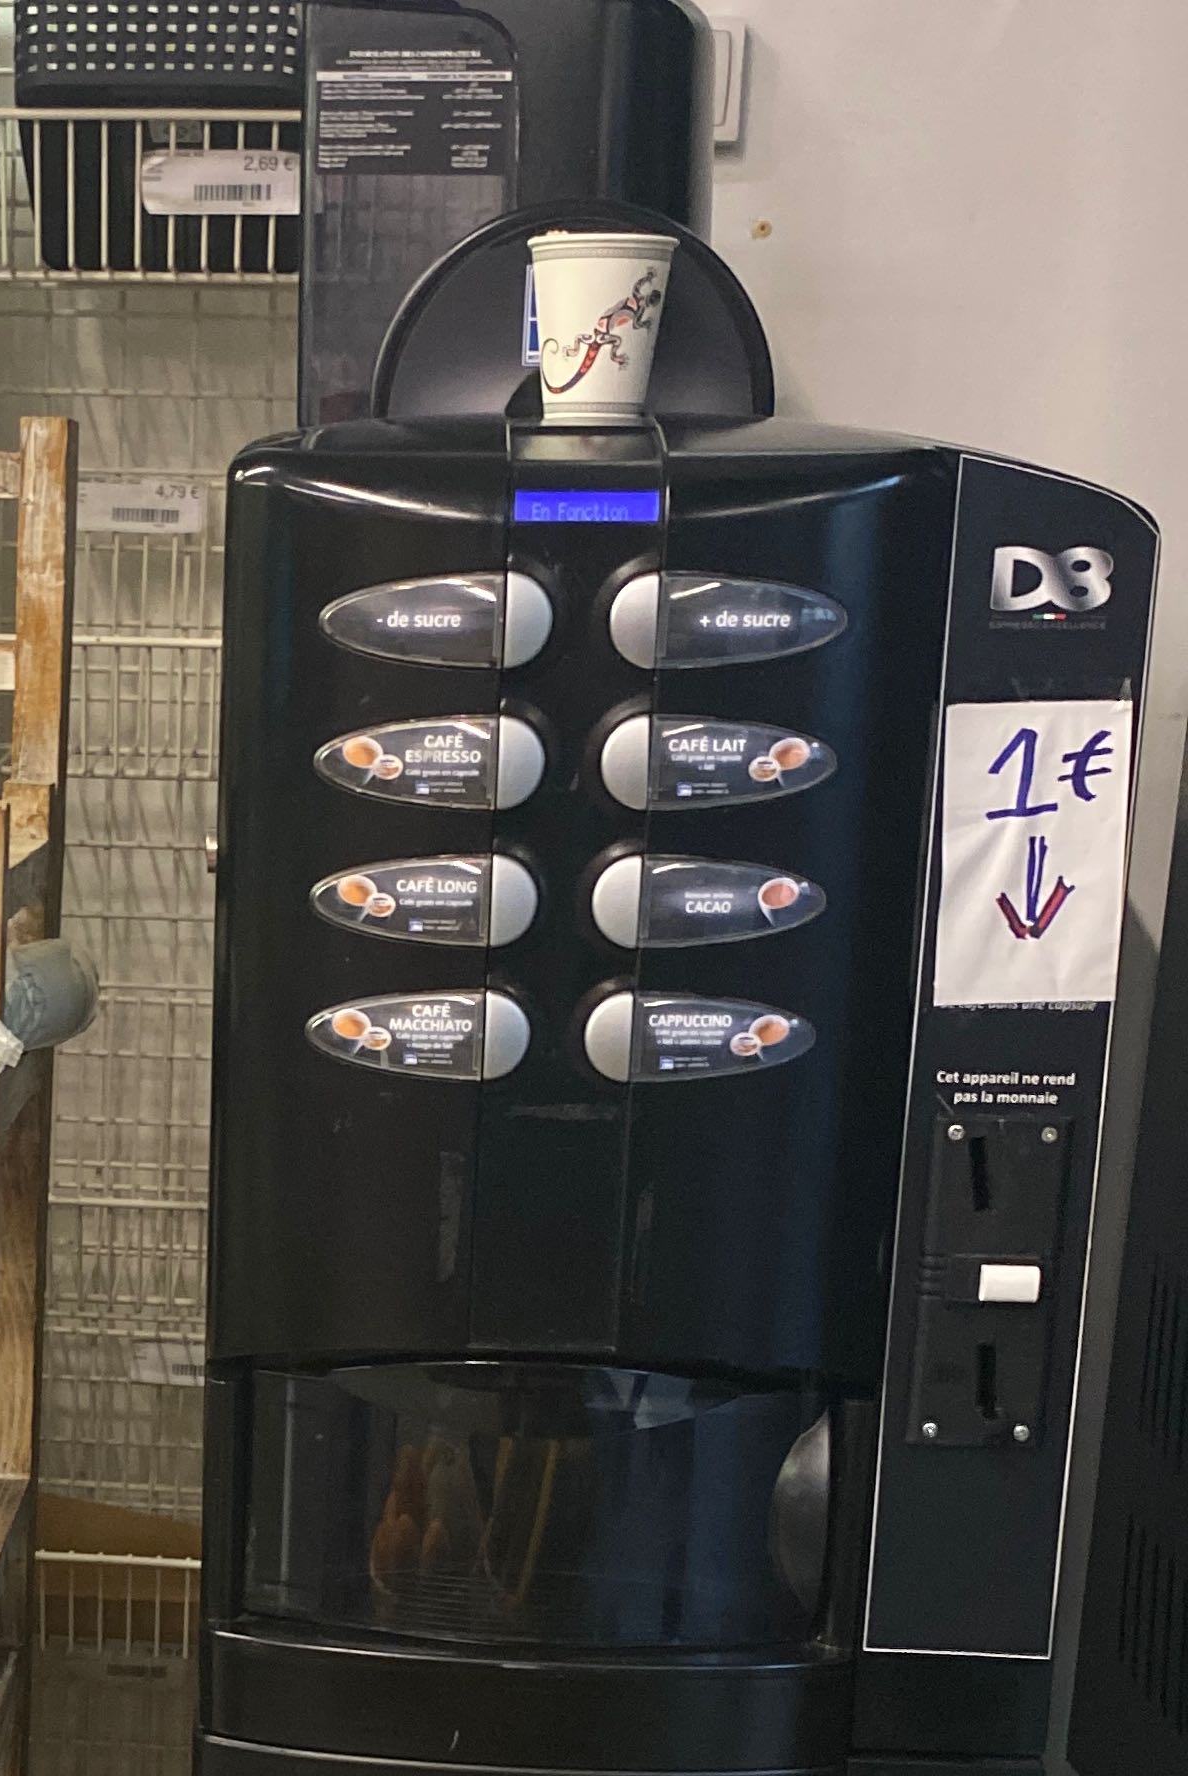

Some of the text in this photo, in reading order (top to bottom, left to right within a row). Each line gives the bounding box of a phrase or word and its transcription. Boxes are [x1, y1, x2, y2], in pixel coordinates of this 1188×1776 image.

[243, 156, 295, 174] 2,69 €
[531, 502, 552, 521] En
[990, 545, 1114, 611] D8
[386, 612, 410, 629] de
[414, 614, 462, 629] sucre
[699, 610, 792, 628] + de sucre
[424, 733, 464, 749] CAFÉ
[668, 736, 748, 752] CAFÉ LAIT
[405, 750, 482, 764] ESPRESSO
[986, 728, 1114, 820] 1 €
[396, 877, 478, 893] CAFÉ LONG
[685, 900, 732, 913] CACAO
[412, 1002, 451, 1018] CAFÉ
[389, 1018, 473, 1032] MACCHIATO
[649, 1014, 733, 1028] CAPPUCCINO
[936, 1070, 1076, 1087] Cet appareil ne rend
[954, 1090, 1059, 1105] pas la monnaie
